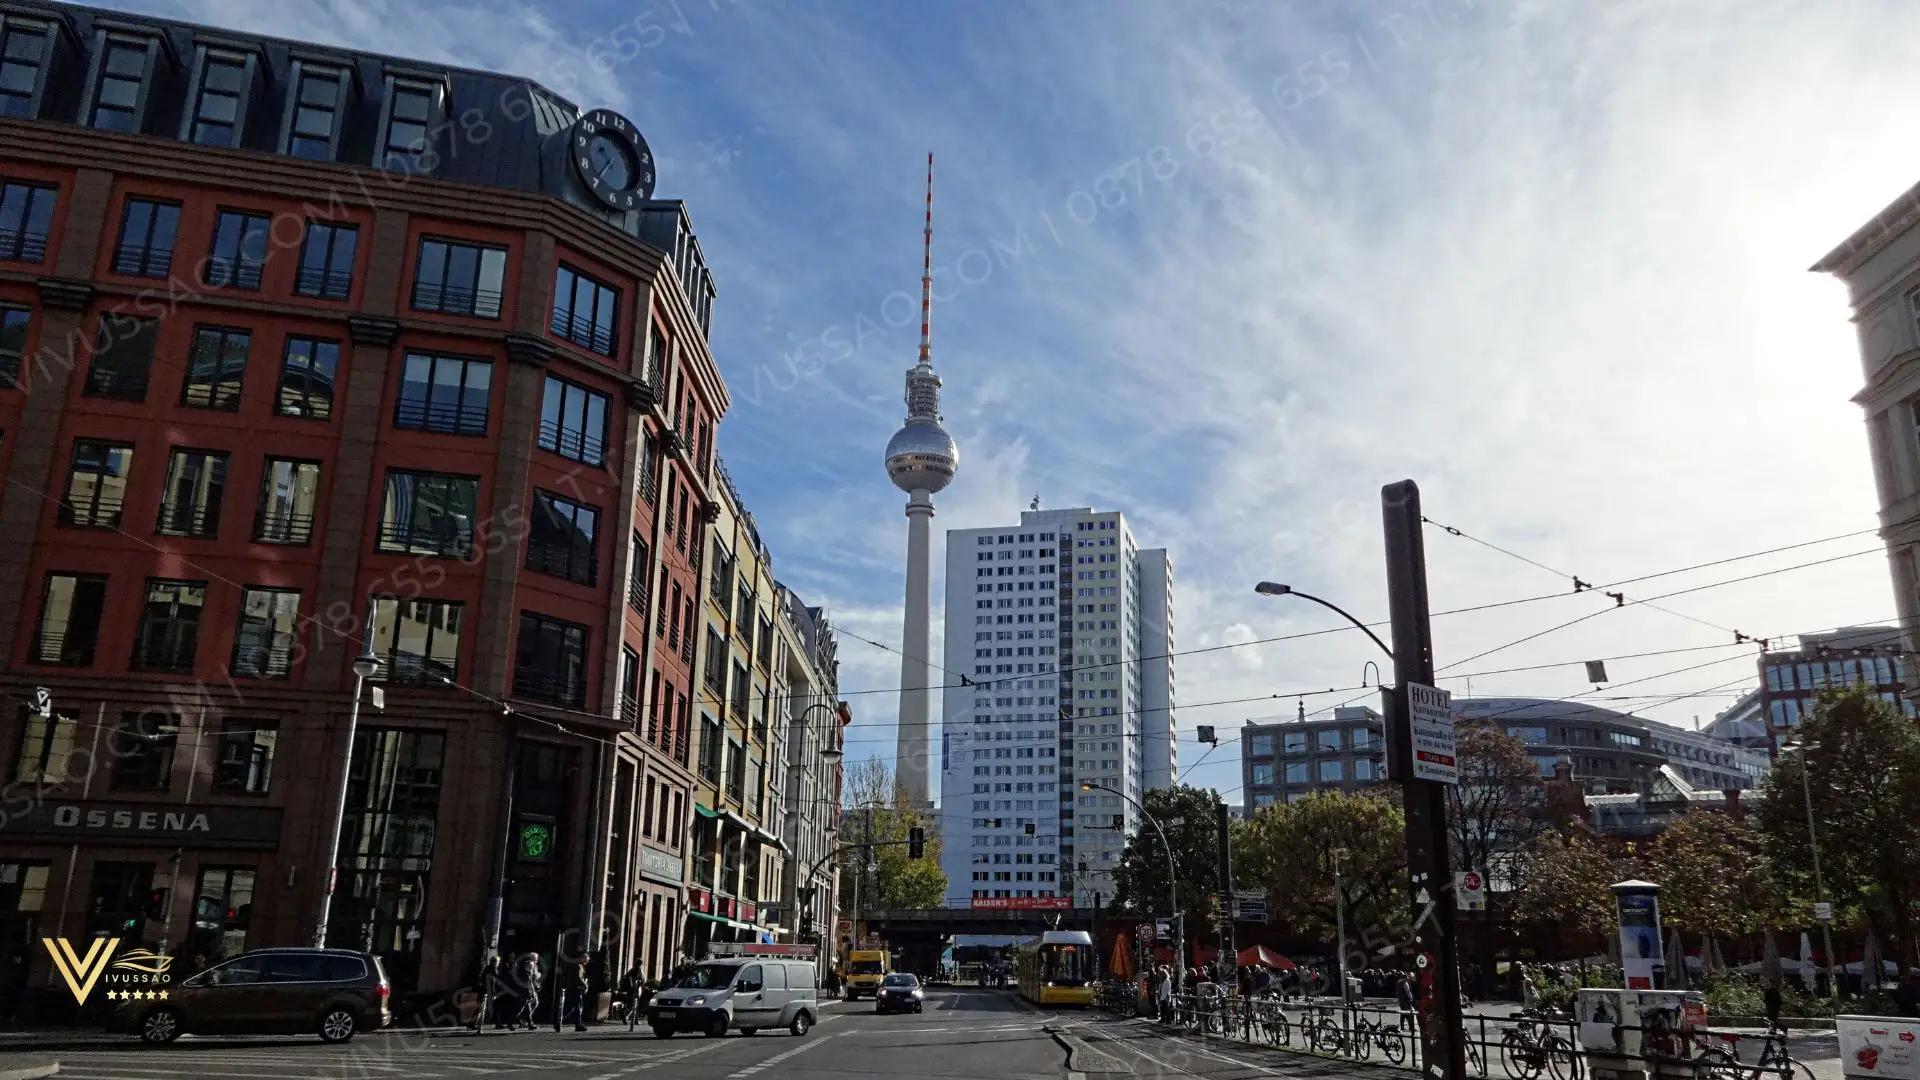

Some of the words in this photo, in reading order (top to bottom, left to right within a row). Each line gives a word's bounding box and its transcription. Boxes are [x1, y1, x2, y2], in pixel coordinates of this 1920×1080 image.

[596, 112, 606, 126] 11
[614, 116, 625, 130] 12
[583, 120, 595, 133] 10
[579, 136, 586, 146] 9
[634, 133, 638, 144] 1
[582, 158, 588, 168] 8
[642, 153, 648, 164] 2
[593, 178, 599, 188] 7
[645, 172, 651, 183] 3
[609, 193, 616, 203] 6
[637, 188, 644, 198] 4
[626, 196, 632, 206] 5
[1412, 686, 1450, 708] HOTEL
[54, 805, 210, 832] OSSENA
